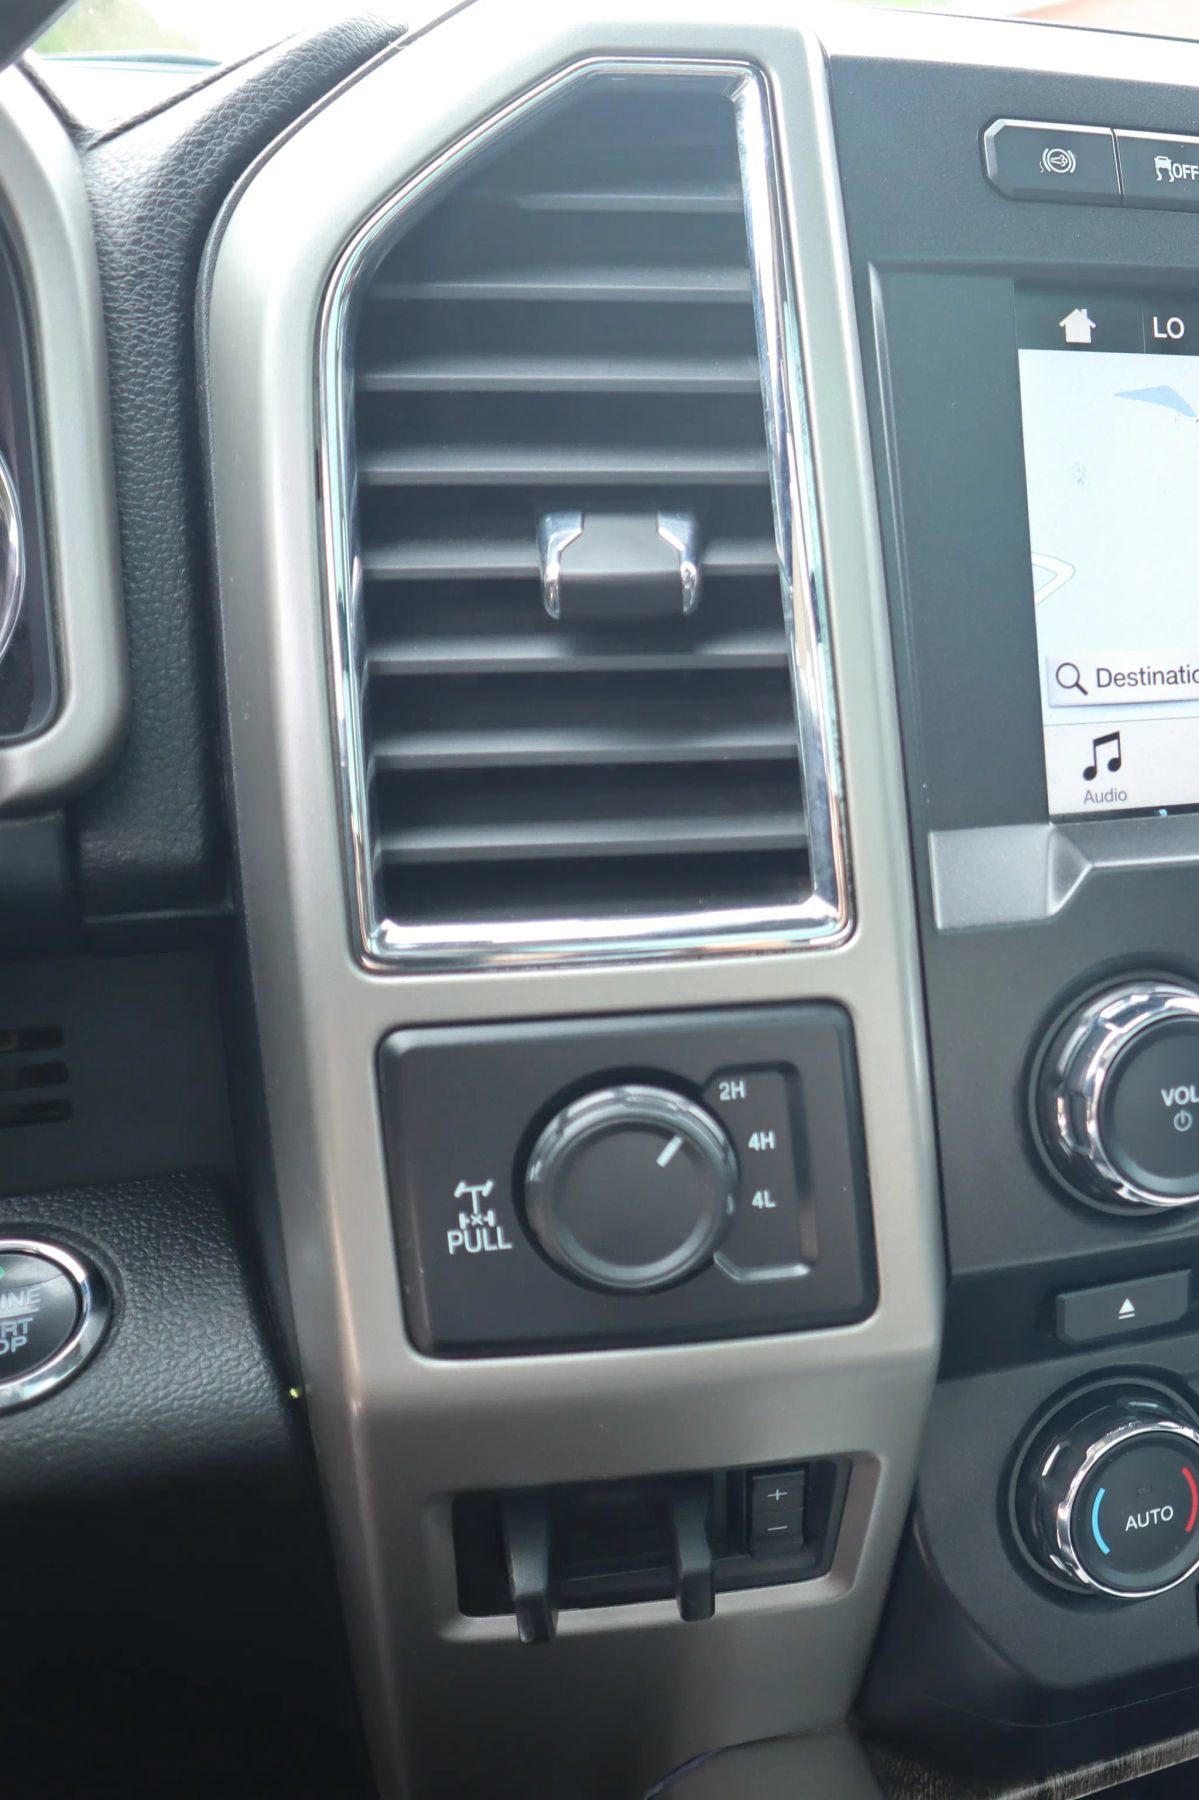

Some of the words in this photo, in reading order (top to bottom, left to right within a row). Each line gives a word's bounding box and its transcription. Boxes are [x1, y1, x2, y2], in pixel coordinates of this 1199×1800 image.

[1172, 163, 1199, 180] OFF
[1153, 316, 1185, 340] LO
[1083, 789, 1128, 805] Audio
[719, 1080, 747, 1100] 2H
[748, 1131, 776, 1151] 4H
[751, 1189, 776, 1209] 4L
[446, 1227, 512, 1255] PULL
[1125, 1505, 1174, 1532] AUTO
